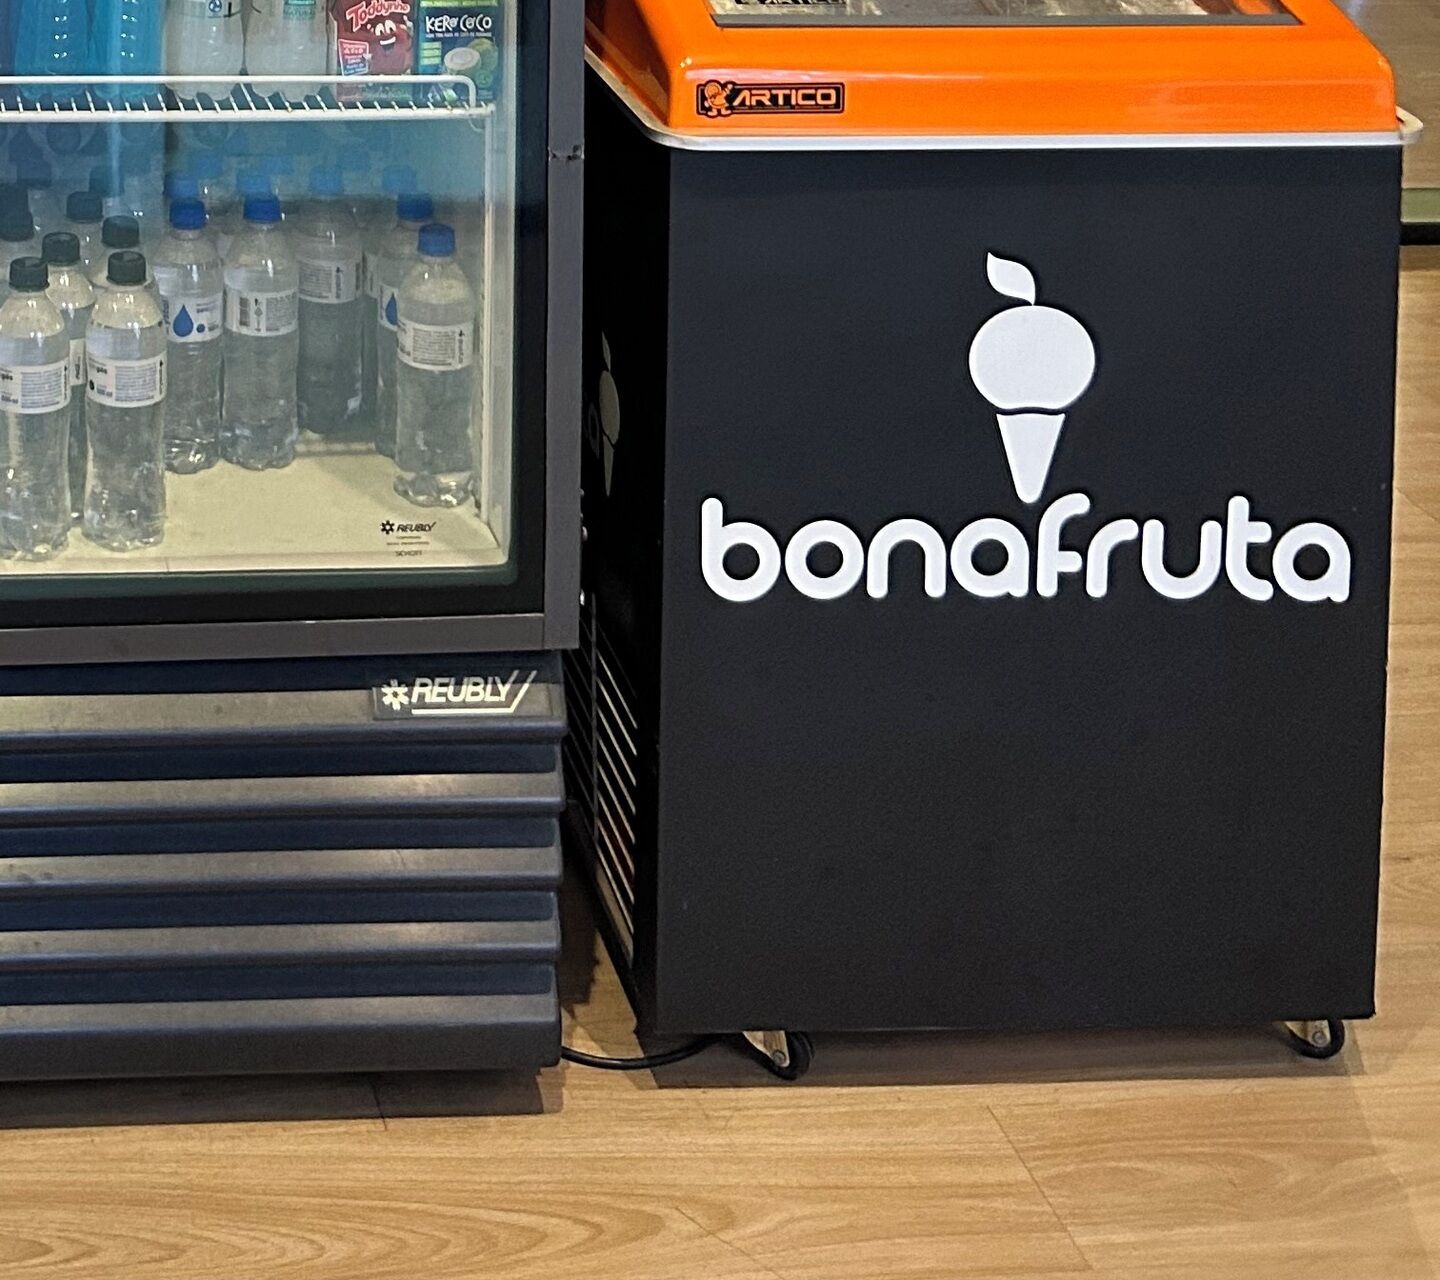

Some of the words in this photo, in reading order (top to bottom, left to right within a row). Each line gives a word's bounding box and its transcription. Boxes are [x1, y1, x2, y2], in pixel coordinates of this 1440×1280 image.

[425, 14, 460, 33] KERO
[460, 13, 492, 30] COCO
[732, 87, 838, 107] ARTICO
[700, 491, 1352, 603] bonafruta
[410, 672, 518, 704] REUBLY
